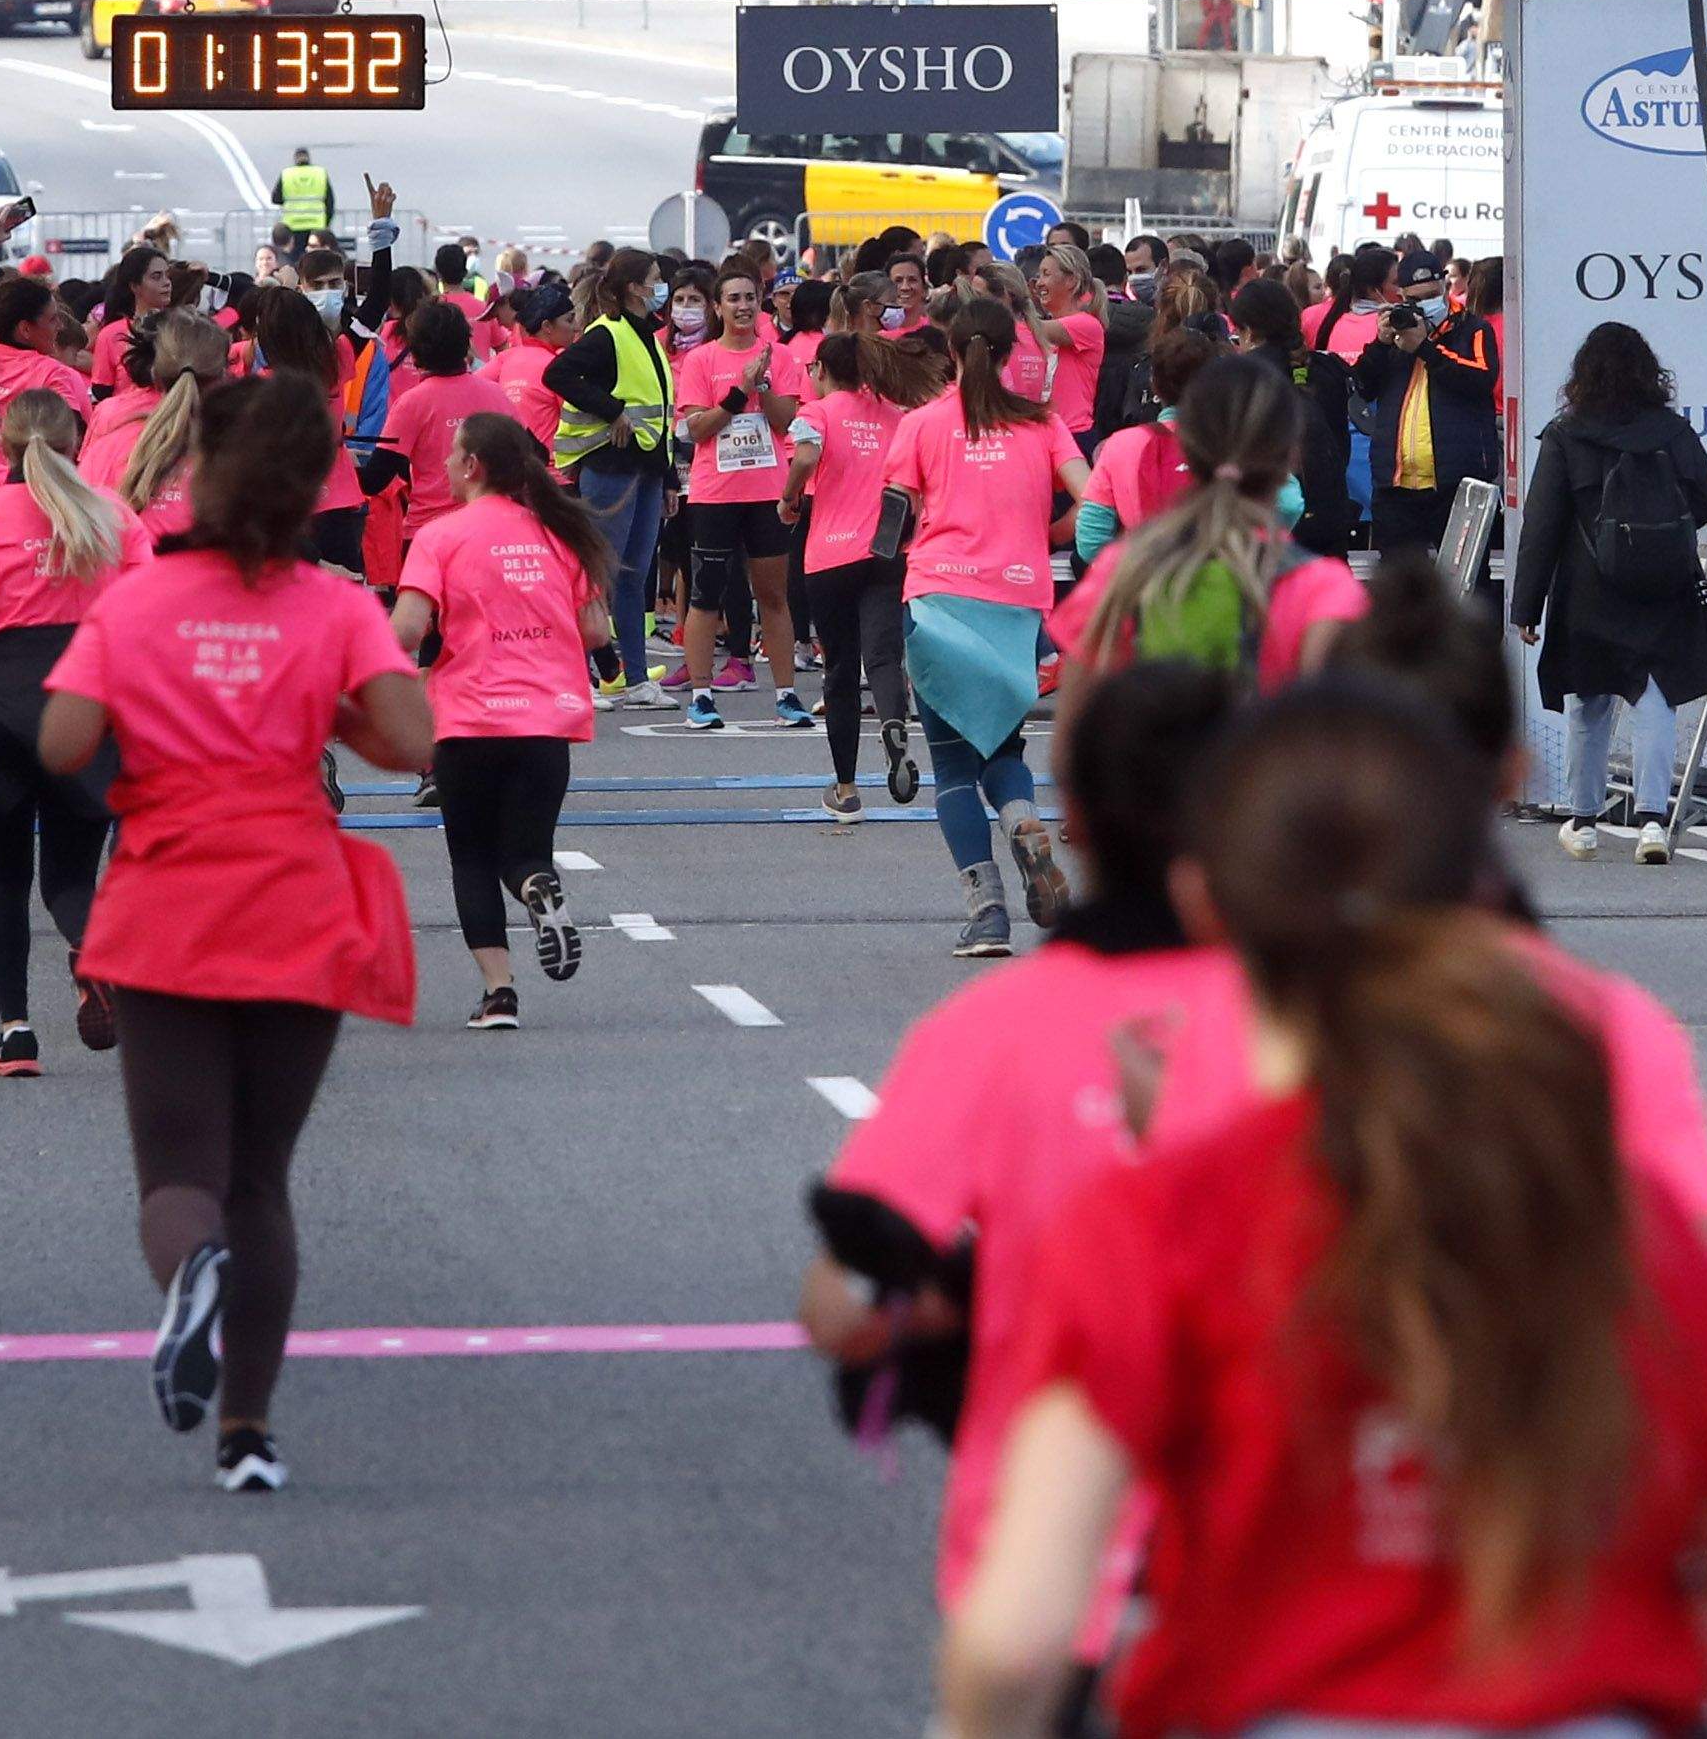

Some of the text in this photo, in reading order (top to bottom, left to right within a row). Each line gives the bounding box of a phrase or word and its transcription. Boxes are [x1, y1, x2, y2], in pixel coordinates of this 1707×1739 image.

[132, 30, 402, 94] 01:13:32
[783, 45, 1014, 93] OYSHO
[1635, 85, 1699, 96] CENTRA
[1389, 126, 1450, 138] CENTRE
[1412, 202, 1467, 220] Creu
[987, 440, 1004, 450] LA
[964, 451, 1007, 462] MUJER
[503, 559, 541, 569] DE LA
[503, 572, 545, 583] MUJER
